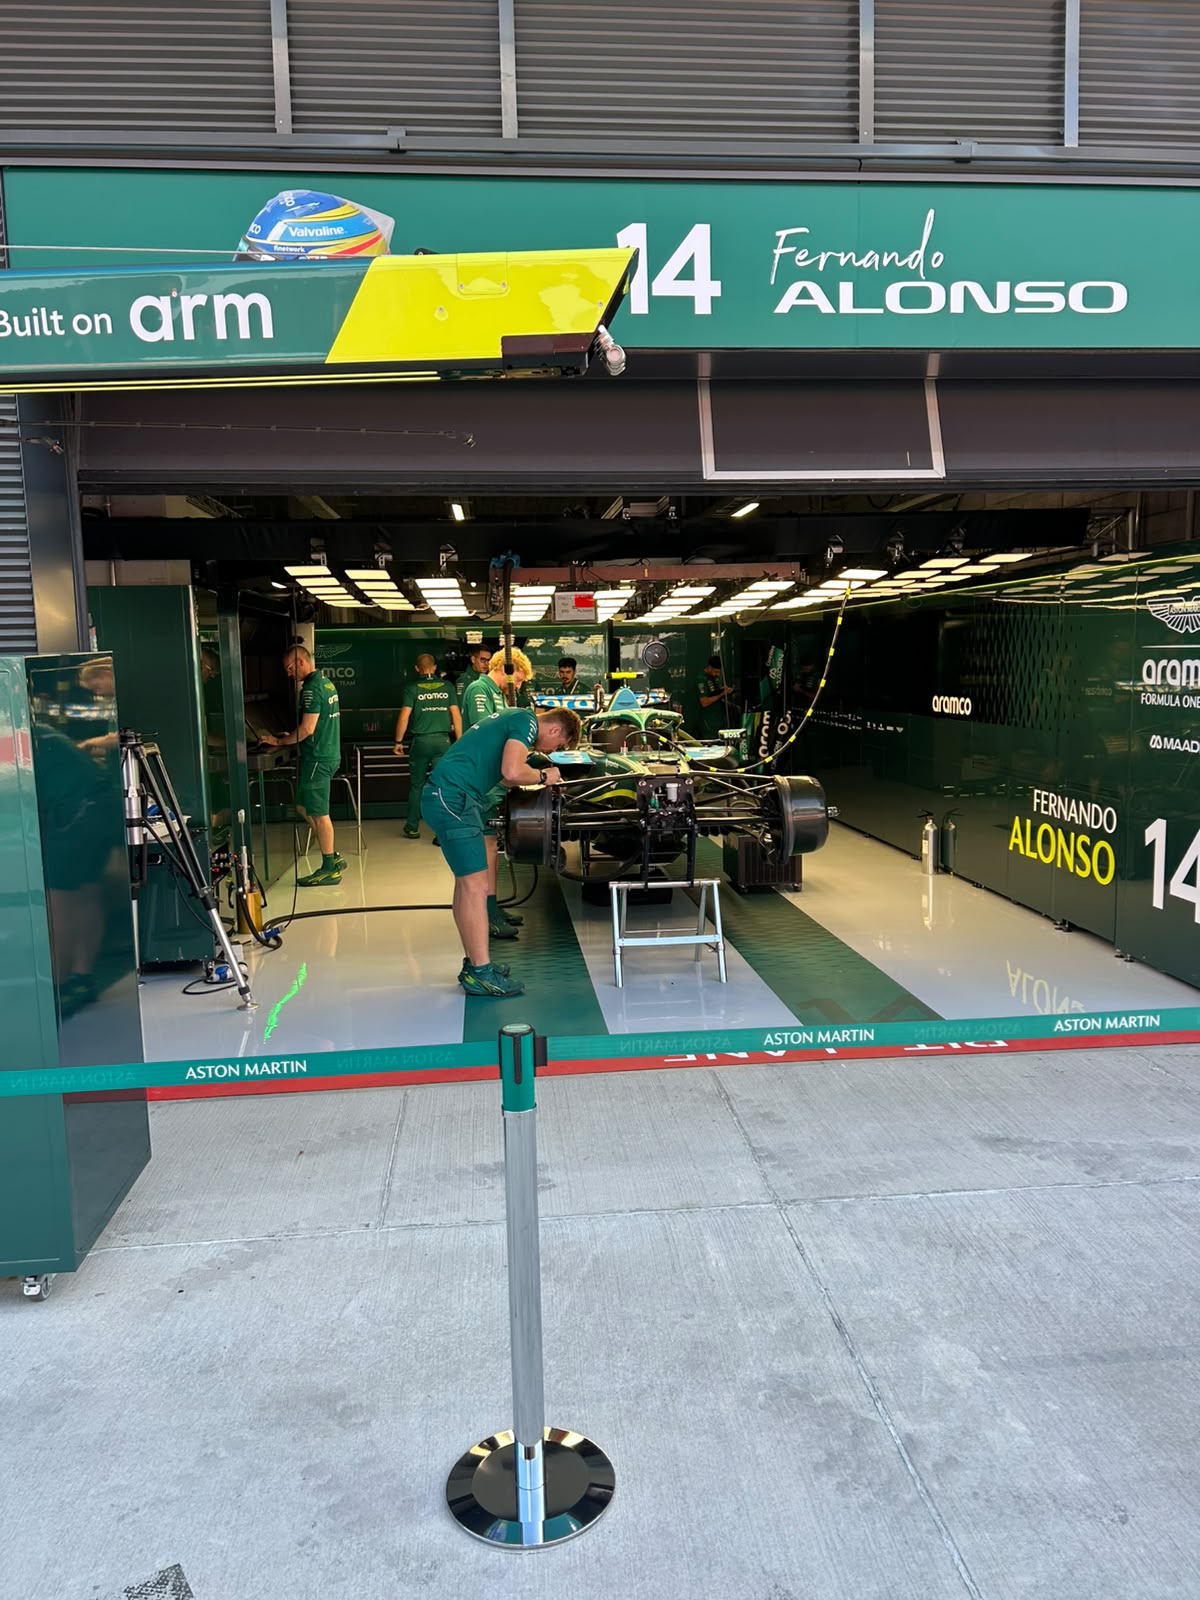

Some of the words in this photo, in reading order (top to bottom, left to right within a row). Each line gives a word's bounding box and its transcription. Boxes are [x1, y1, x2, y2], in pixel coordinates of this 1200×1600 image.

[288, 226, 345, 237] Valvoline
[273, 245, 305, 253] finetwork
[770, 208, 944, 285] Fernando
[616, 223, 721, 315] 14
[773, 280, 1128, 314] ALONSO
[0, 307, 65, 338] Built
[72, 312, 113, 335] on
[129, 292, 274, 342] arm
[418, 692, 448, 701] aramco
[932, 695, 971, 716] aramco
[1141, 693, 1181, 707] FORMULA
[1182, 695, 1200, 709] ONE
[1033, 789, 1117, 834] FERNANDO
[1008, 815, 1115, 886] ALONSO
[1144, 818, 1200, 924] 14
[1053, 1017, 1102, 1032] ASTON
[1105, 1014, 1160, 1029] MARTIN
[763, 1031, 814, 1046] ASTON
[817, 1028, 875, 1043] MARTIN
[185, 1064, 240, 1080] ASTON
[244, 1060, 307, 1077] MARTIN
